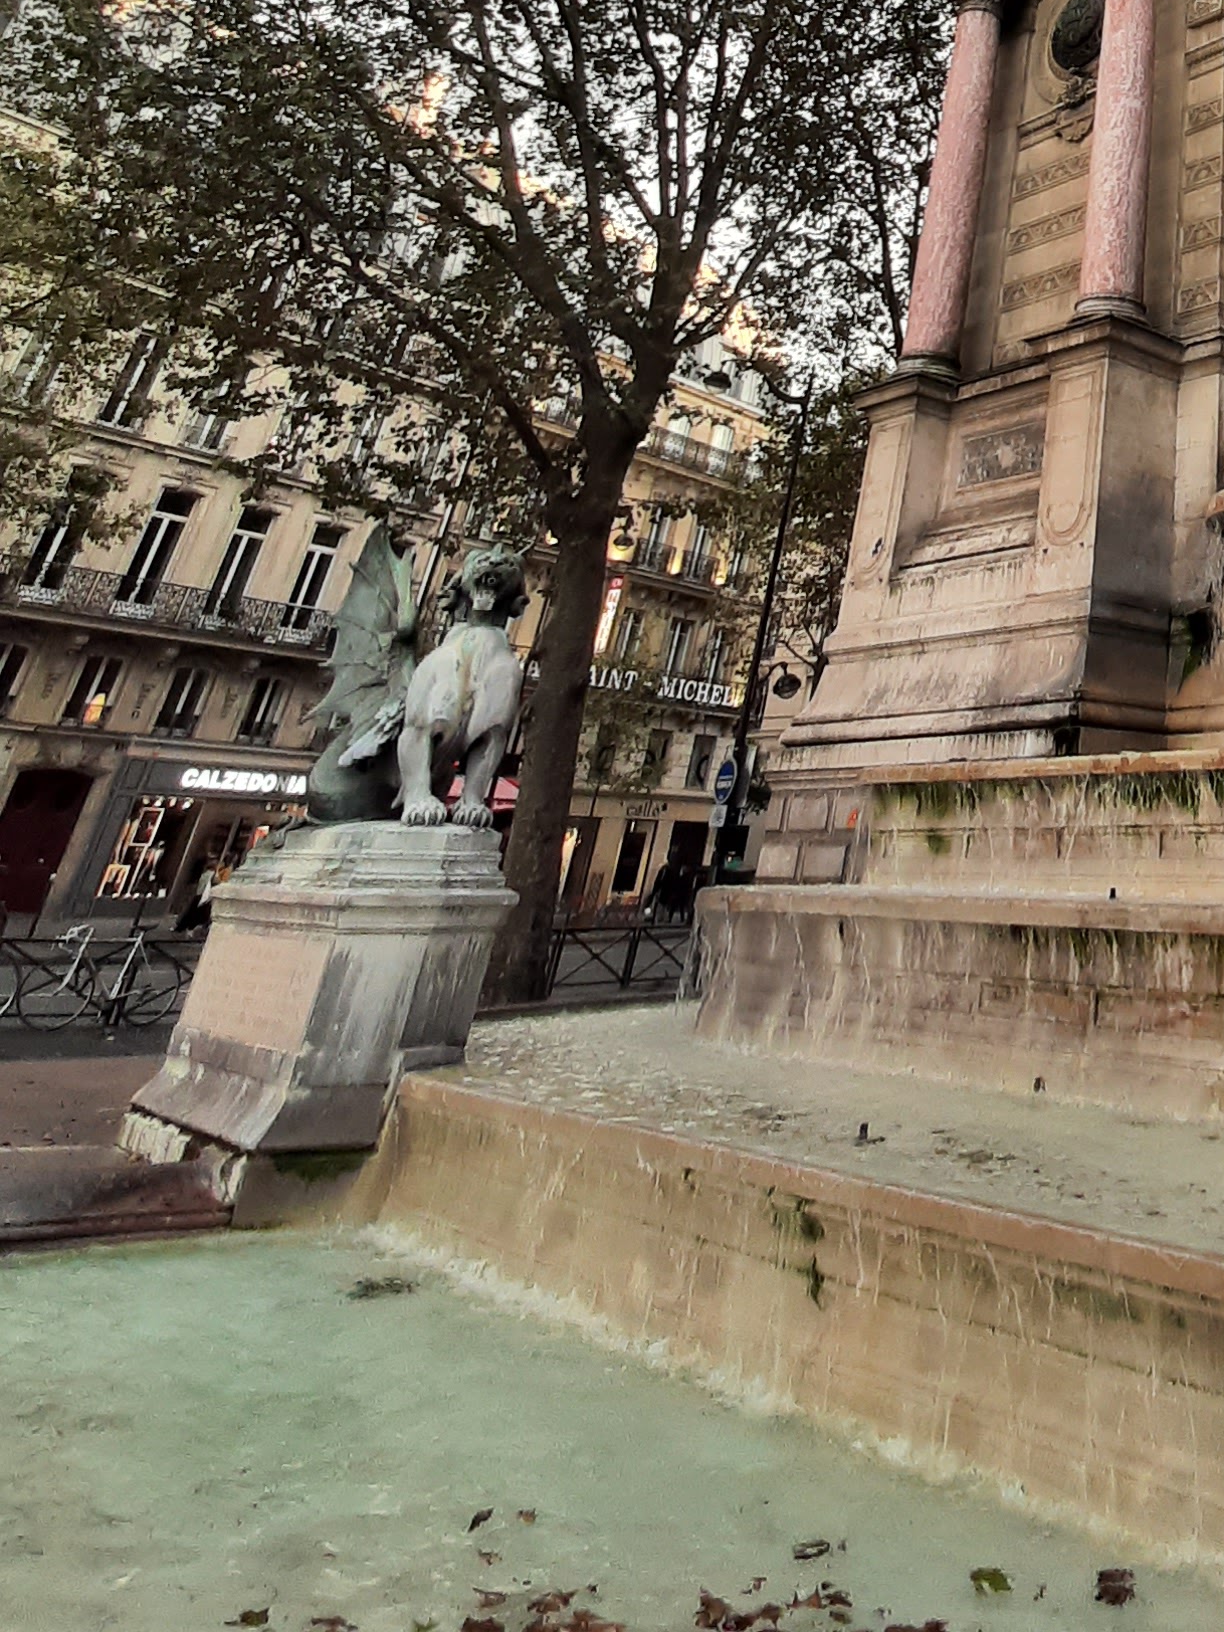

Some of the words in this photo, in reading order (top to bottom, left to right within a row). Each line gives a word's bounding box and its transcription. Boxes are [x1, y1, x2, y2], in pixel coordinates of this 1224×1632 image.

[588, 665, 638, 691] AINT
[657, 675, 736, 707] MICHEL
[181, 768, 307, 796] CALZEDONIA
